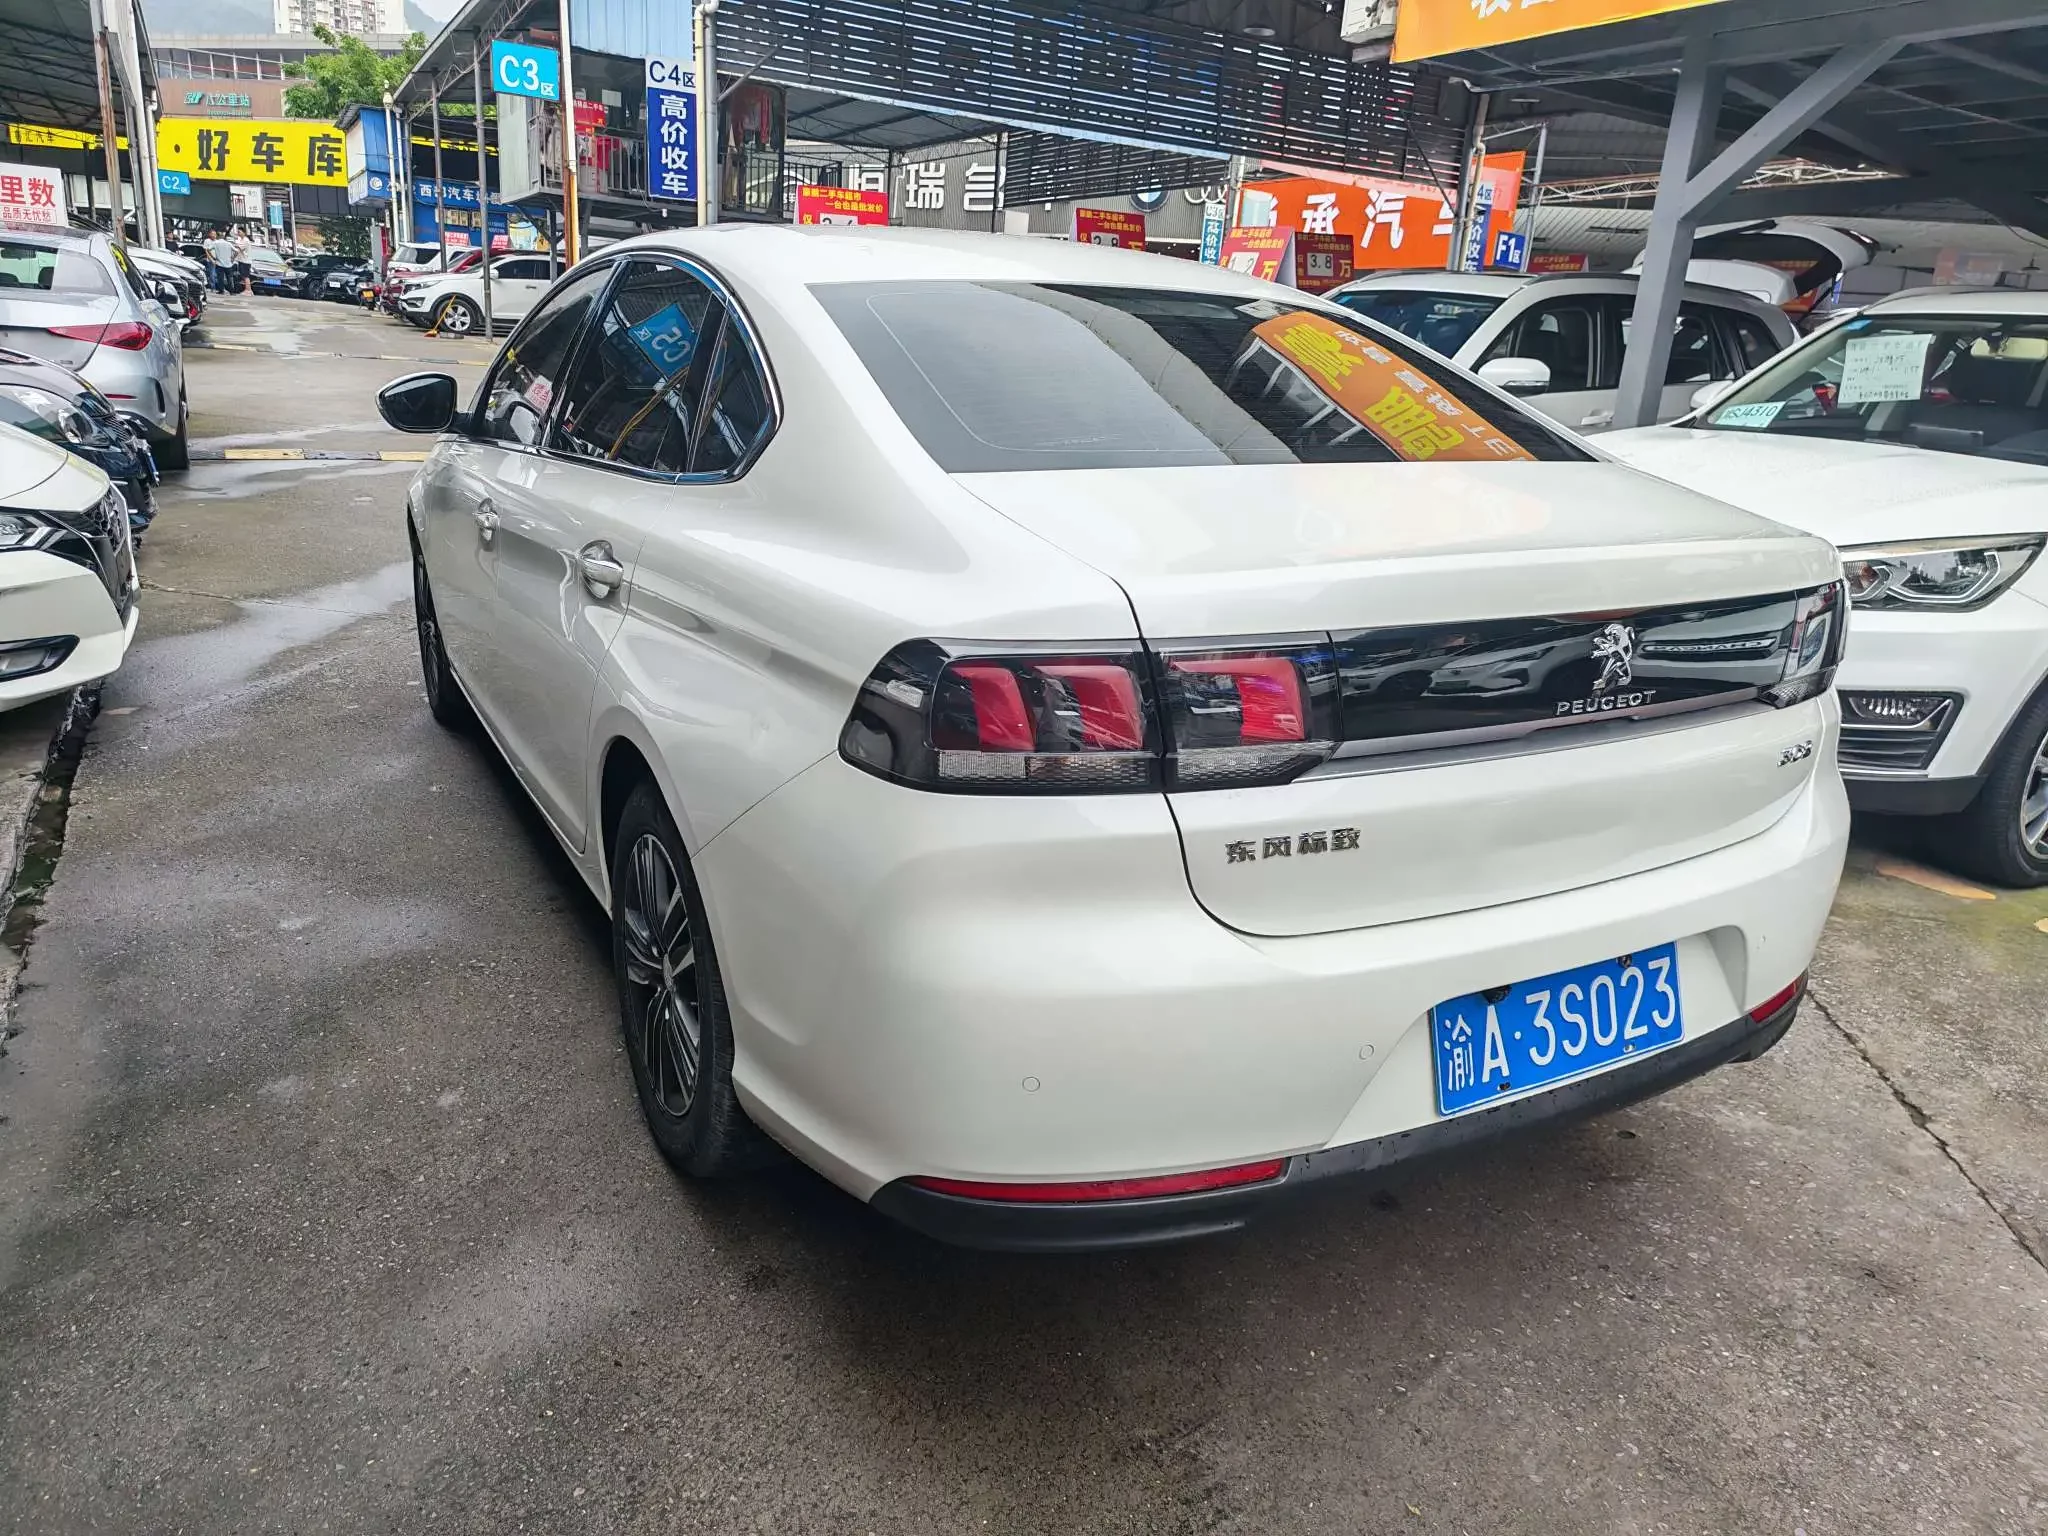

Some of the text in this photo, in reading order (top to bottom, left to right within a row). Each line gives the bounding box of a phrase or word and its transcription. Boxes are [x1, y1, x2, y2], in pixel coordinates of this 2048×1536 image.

[499, 54, 554, 95] C3区
[649, 60, 696, 87] C4区
[197, 128, 342, 177] 好车库
[659, 94, 689, 195] 高价收车
[0, 175, 56, 208] 里数
[1268, 189, 1455, 249] 承汽
[1310, 254, 1332, 269] 3.8
[1339, 259, 1352, 278] 万
[1496, 234, 1522, 264] F1区
[1555, 689, 1657, 716] PEUGEOT
[1224, 827, 1362, 864] 东风标致
